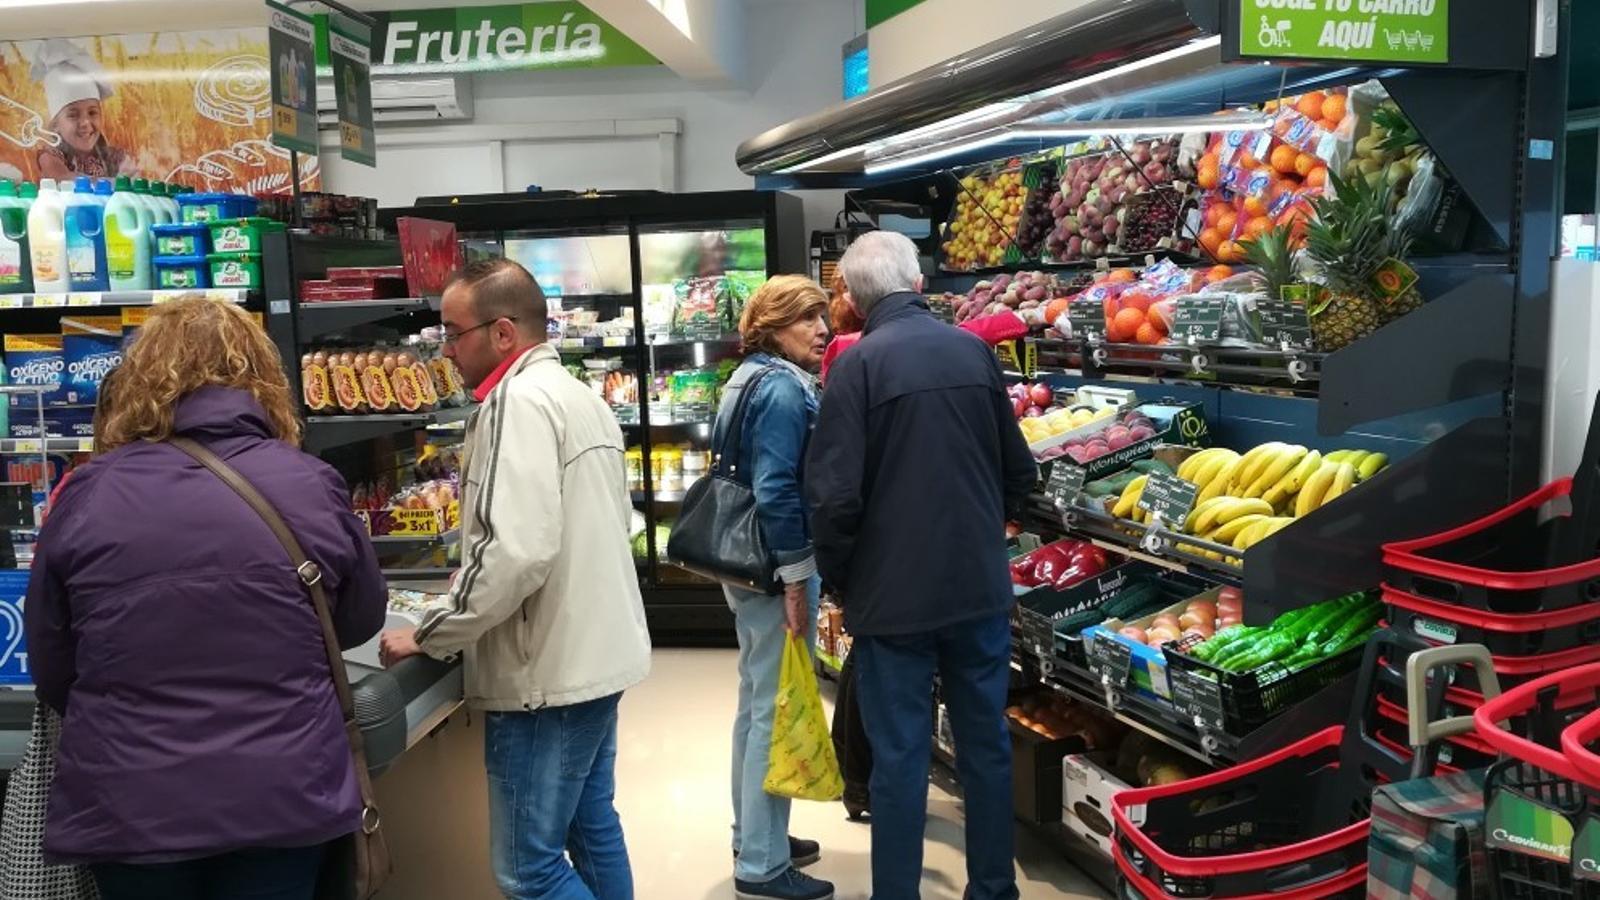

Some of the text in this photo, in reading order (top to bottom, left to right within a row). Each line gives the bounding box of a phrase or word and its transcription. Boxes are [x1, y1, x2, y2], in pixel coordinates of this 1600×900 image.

[383, 12, 601, 65] Frutería
[1317, 16, 1378, 51] AQUÍ
[11, 360, 65, 378] OXÍGENO
[68, 355, 122, 374] OXÍGENO
[72, 368, 107, 384] ACTIV
